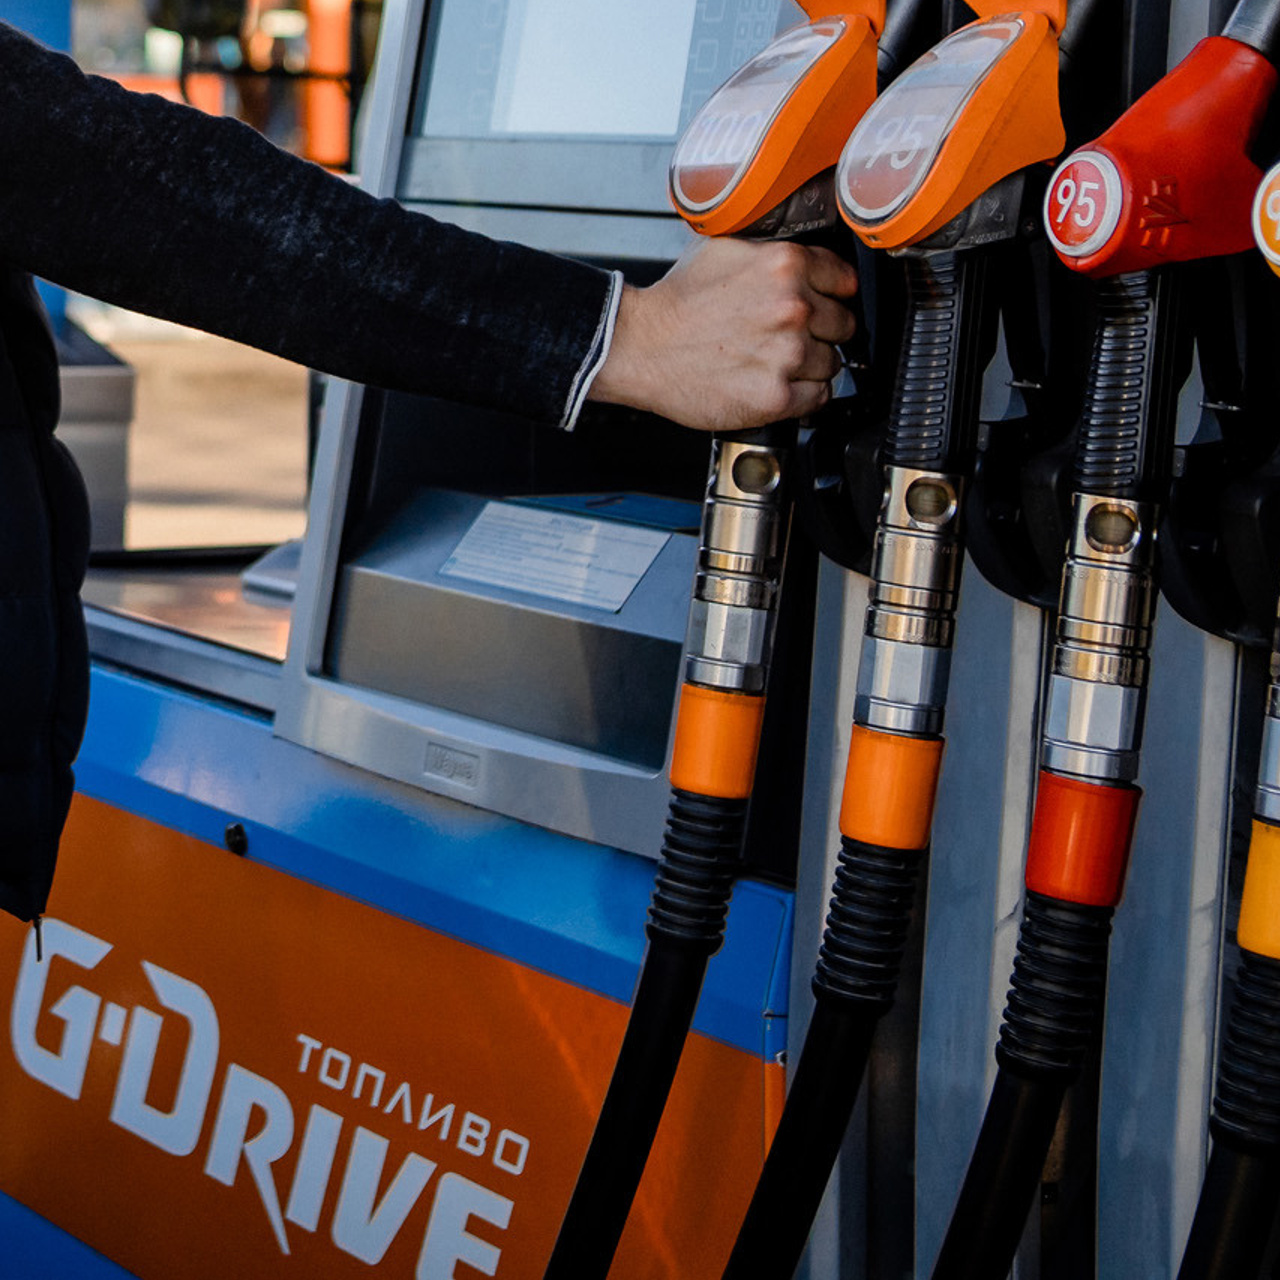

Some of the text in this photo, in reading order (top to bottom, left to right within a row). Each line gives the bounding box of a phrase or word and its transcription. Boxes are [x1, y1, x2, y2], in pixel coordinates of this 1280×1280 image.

[689, 110, 763, 164] 100
[865, 114, 937, 170] 95
[1056, 178, 1099, 227] 95
[297, 1033, 530, 1175] ТОПЛИВО
